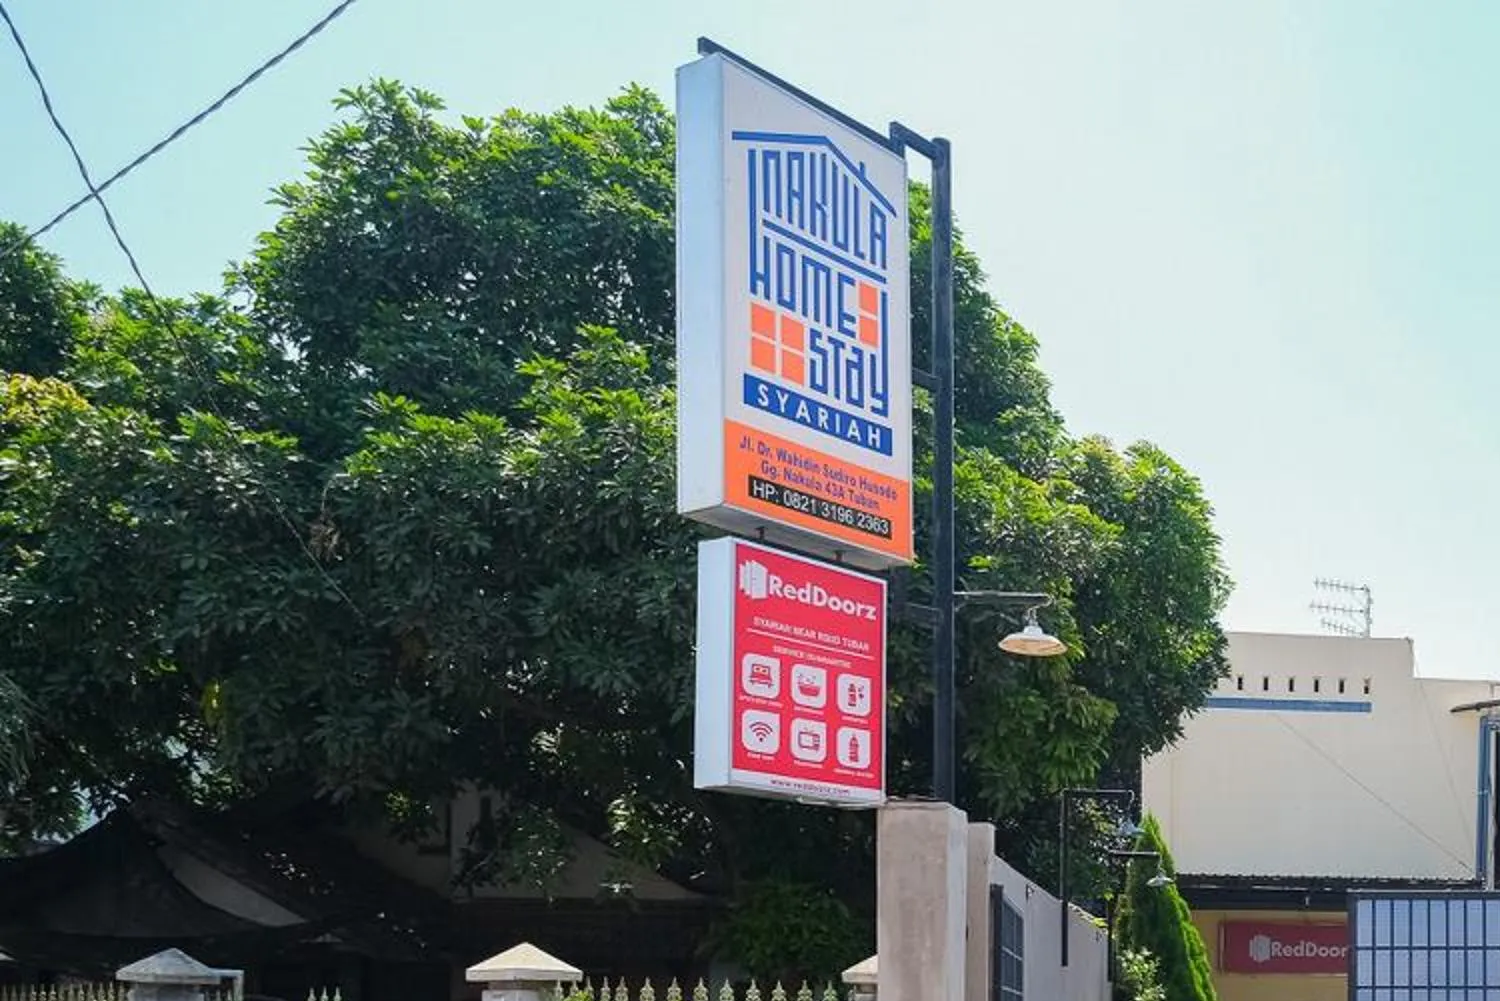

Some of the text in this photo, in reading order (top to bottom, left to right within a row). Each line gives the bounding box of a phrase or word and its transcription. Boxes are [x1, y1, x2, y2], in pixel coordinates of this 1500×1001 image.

[762, 149, 887, 271] NAKULA
[757, 383, 881, 448] SYARIAH
[757, 440, 772, 458] Dr.
[777, 447, 821, 473] Wahidin
[823, 463, 857, 487] Sudiro
[783, 466, 822, 491] Nakula
[752, 479, 889, 535] HP: 0821 3196 2363
[769, 574, 877, 621] RedDoorz
